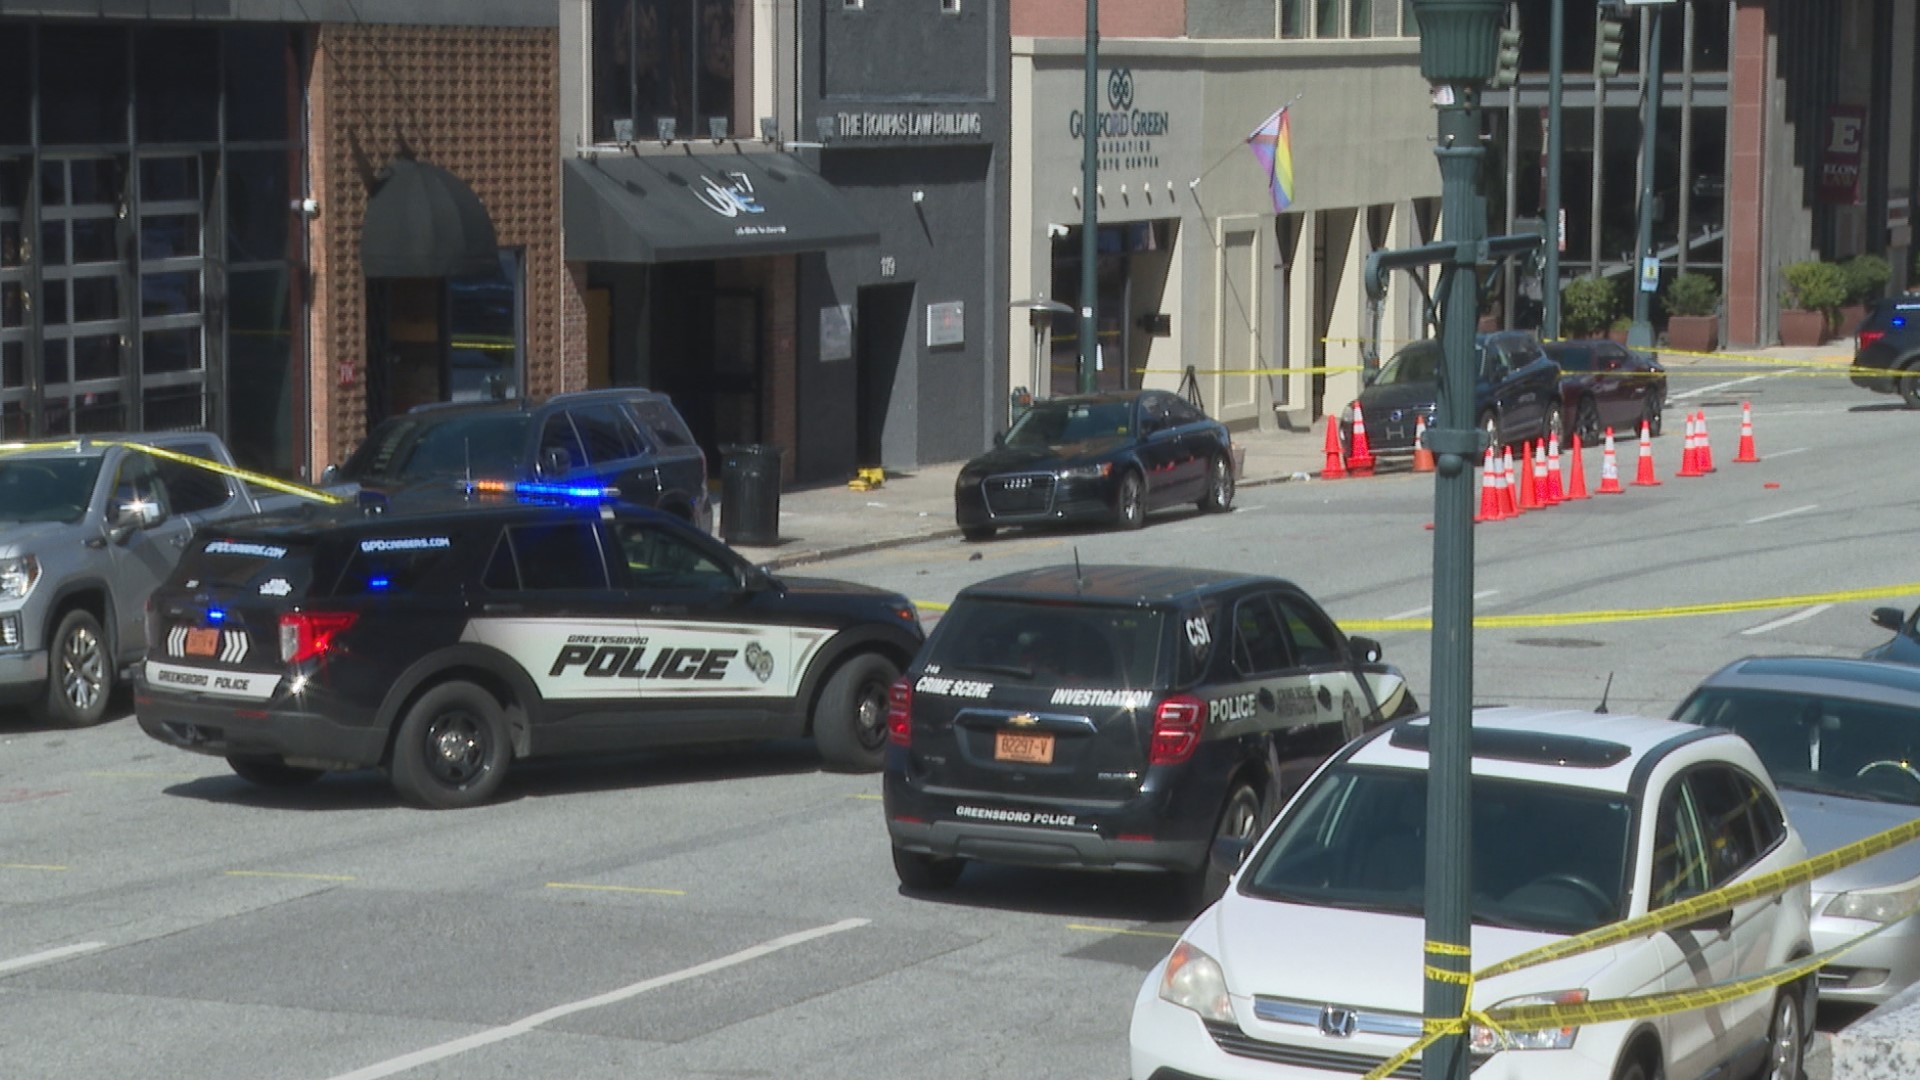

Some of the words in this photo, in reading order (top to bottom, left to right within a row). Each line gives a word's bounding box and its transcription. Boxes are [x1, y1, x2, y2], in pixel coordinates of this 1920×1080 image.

[838, 112, 861, 136] THE
[908, 112, 932, 136] LAW
[933, 111, 981, 134] BUILDING
[1131, 108, 1168, 137] GREEN
[1827, 116, 1861, 154] E
[1823, 163, 1858, 176] ELON
[567, 634, 649, 645] GREENSBORO
[1185, 617, 1211, 646] CSI
[548, 644, 739, 680] POLICE
[158, 670, 209, 687] GREENSBORO
[214, 676, 250, 691] POLICE
[915, 676, 955, 695] CRIME
[950, 679, 994, 699] SCENE
[1051, 688, 1153, 708] INVESTIGATION
[1209, 693, 1257, 724] POLICE
[956, 805, 1030, 823] GREENSBORO
[1033, 812, 1076, 826] POLICE
